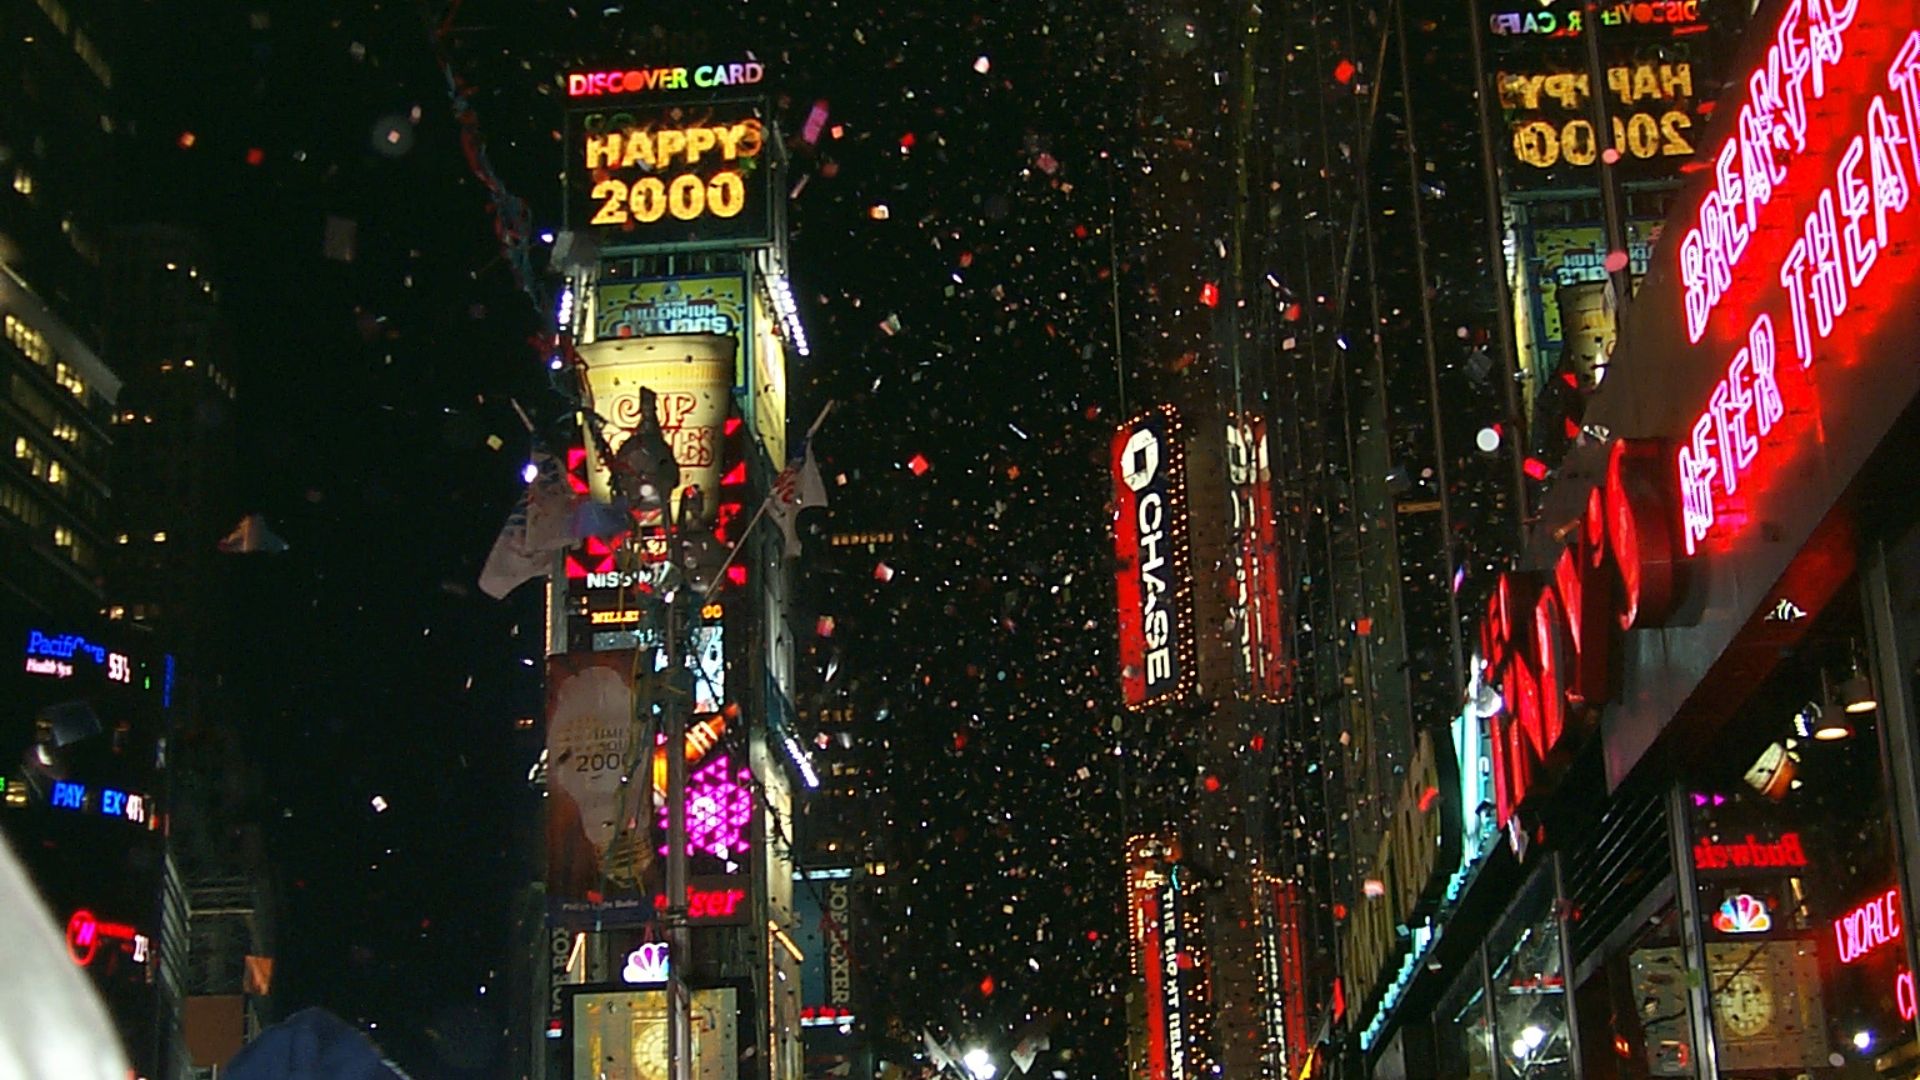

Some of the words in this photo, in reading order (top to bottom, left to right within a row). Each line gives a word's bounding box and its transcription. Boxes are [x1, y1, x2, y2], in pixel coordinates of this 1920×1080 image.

[568, 67, 688, 96] DISCOVER
[694, 63, 764, 88] CARD
[585, 123, 747, 170] HAPPY
[590, 171, 745, 225] 2000
[1138, 493, 1171, 685] CHASE
[830, 882, 848, 923] JOE
